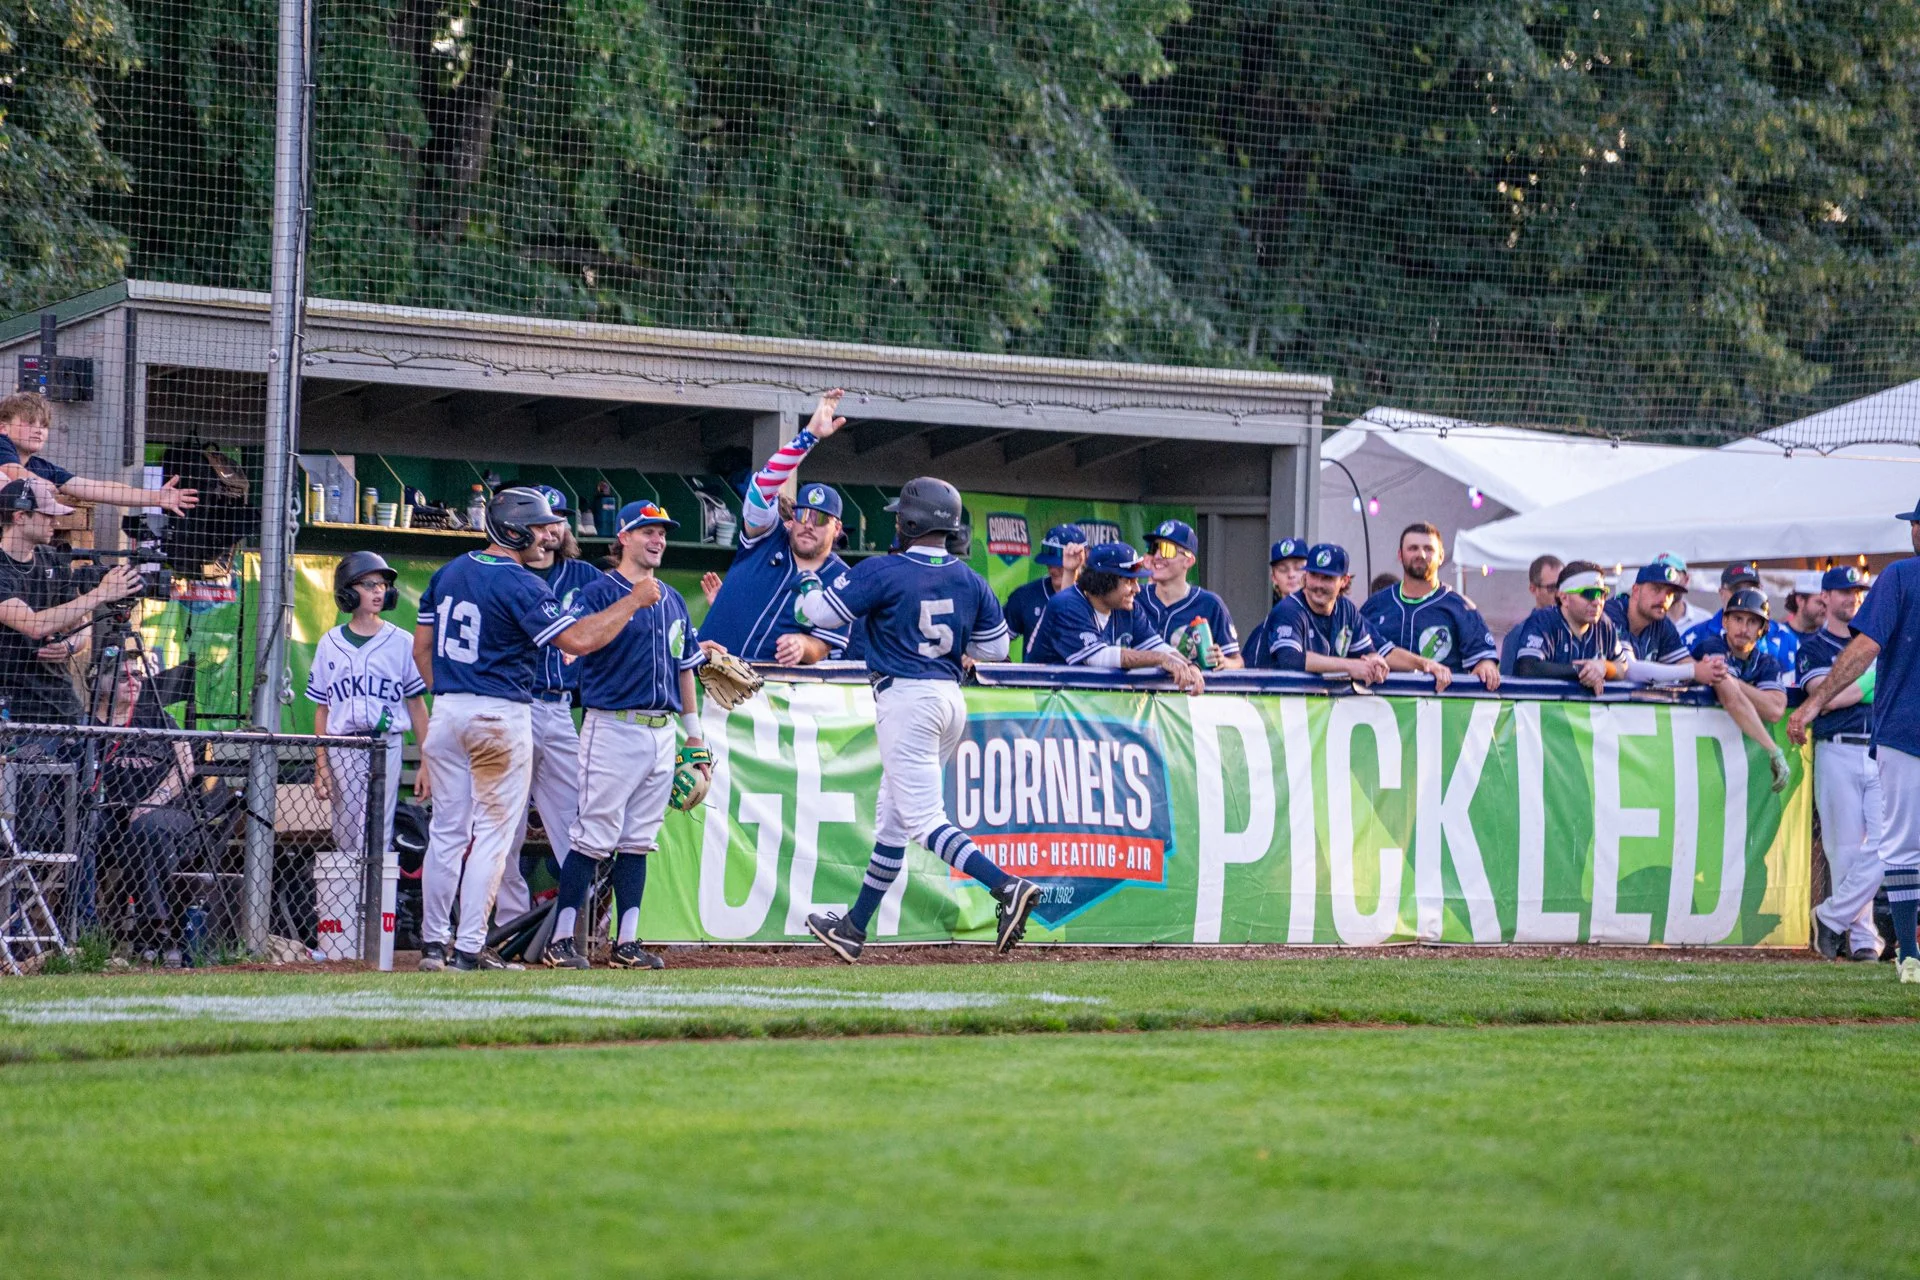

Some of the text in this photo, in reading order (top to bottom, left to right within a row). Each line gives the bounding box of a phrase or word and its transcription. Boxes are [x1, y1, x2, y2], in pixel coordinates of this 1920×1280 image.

[988, 517, 1028, 544] CORNEL'S
[436, 596, 481, 665] 13
[918, 598, 955, 659] 5
[326, 674, 403, 707] PICKLES
[956, 738, 1152, 831] CORNEL'S
[1186, 695, 1750, 947] PICKLED
[1051, 842, 1116, 868] HEATING
[1126, 845, 1152, 871] AIR
[1054, 886, 1075, 904] 1982
